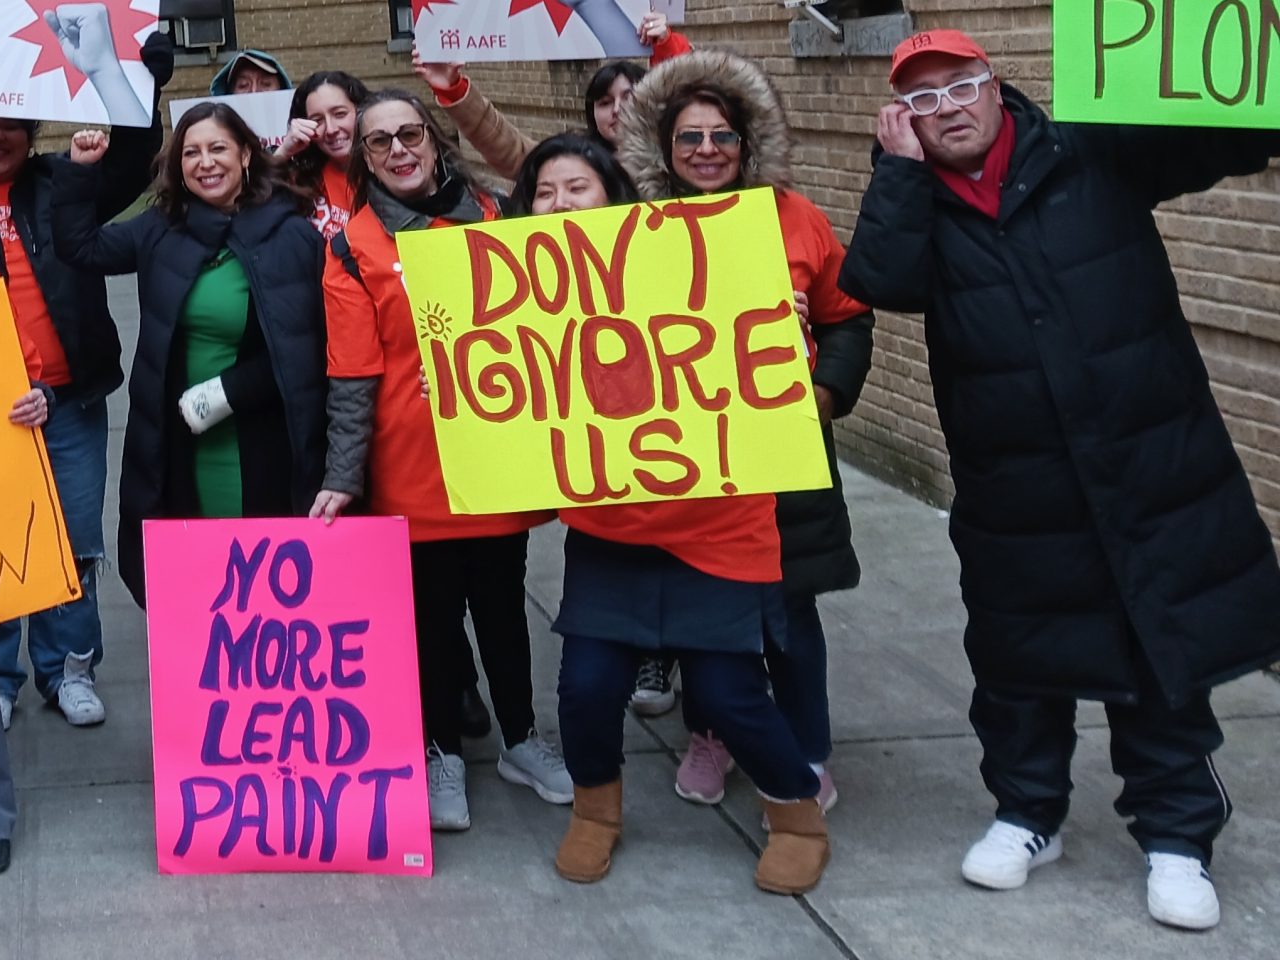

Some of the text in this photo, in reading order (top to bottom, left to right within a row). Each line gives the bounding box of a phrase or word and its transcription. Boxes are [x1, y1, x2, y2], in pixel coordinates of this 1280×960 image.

[466, 34, 508, 50] AAFE
[464, 193, 740, 327] DON'T
[426, 299, 807, 423] IGNORE
[550, 413, 739, 504] US!
[210, 537, 314, 613] NO
[199, 612, 371, 693] MORE
[201, 696, 371, 767] LEAD
